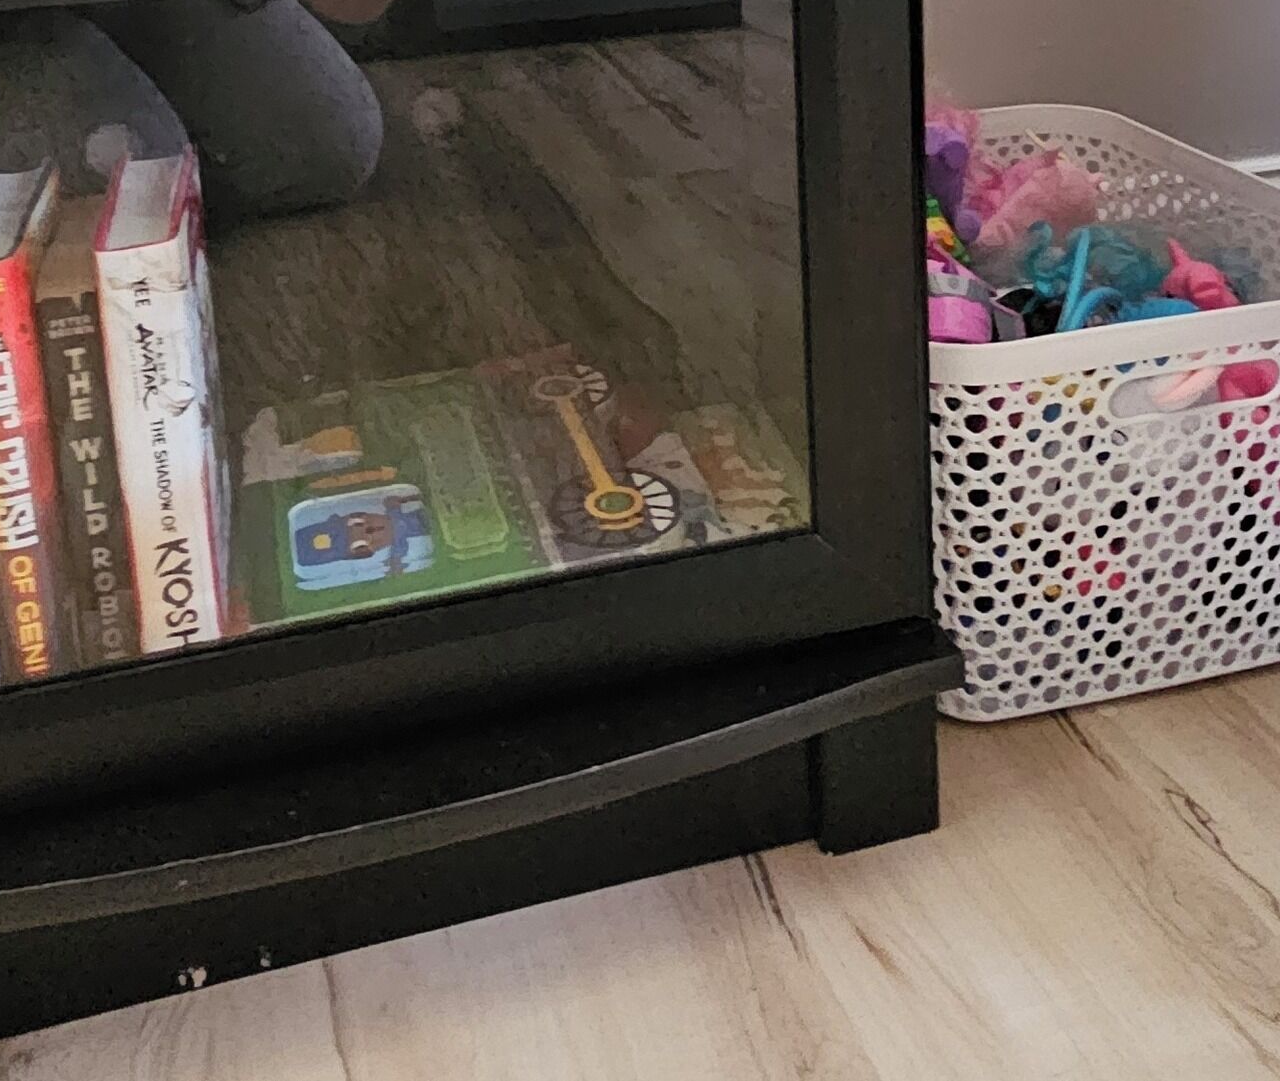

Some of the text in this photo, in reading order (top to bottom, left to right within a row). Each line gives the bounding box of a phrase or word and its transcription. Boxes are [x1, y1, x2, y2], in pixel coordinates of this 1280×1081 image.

[132, 276, 152, 308] YEE
[63, 346, 94, 421] THE
[149, 418, 168, 447] THE
[69, 436, 109, 537] WILD
[153, 449, 174, 512] SHADOW
[162, 515, 178, 533] OF
[8, 555, 38, 594] OF
